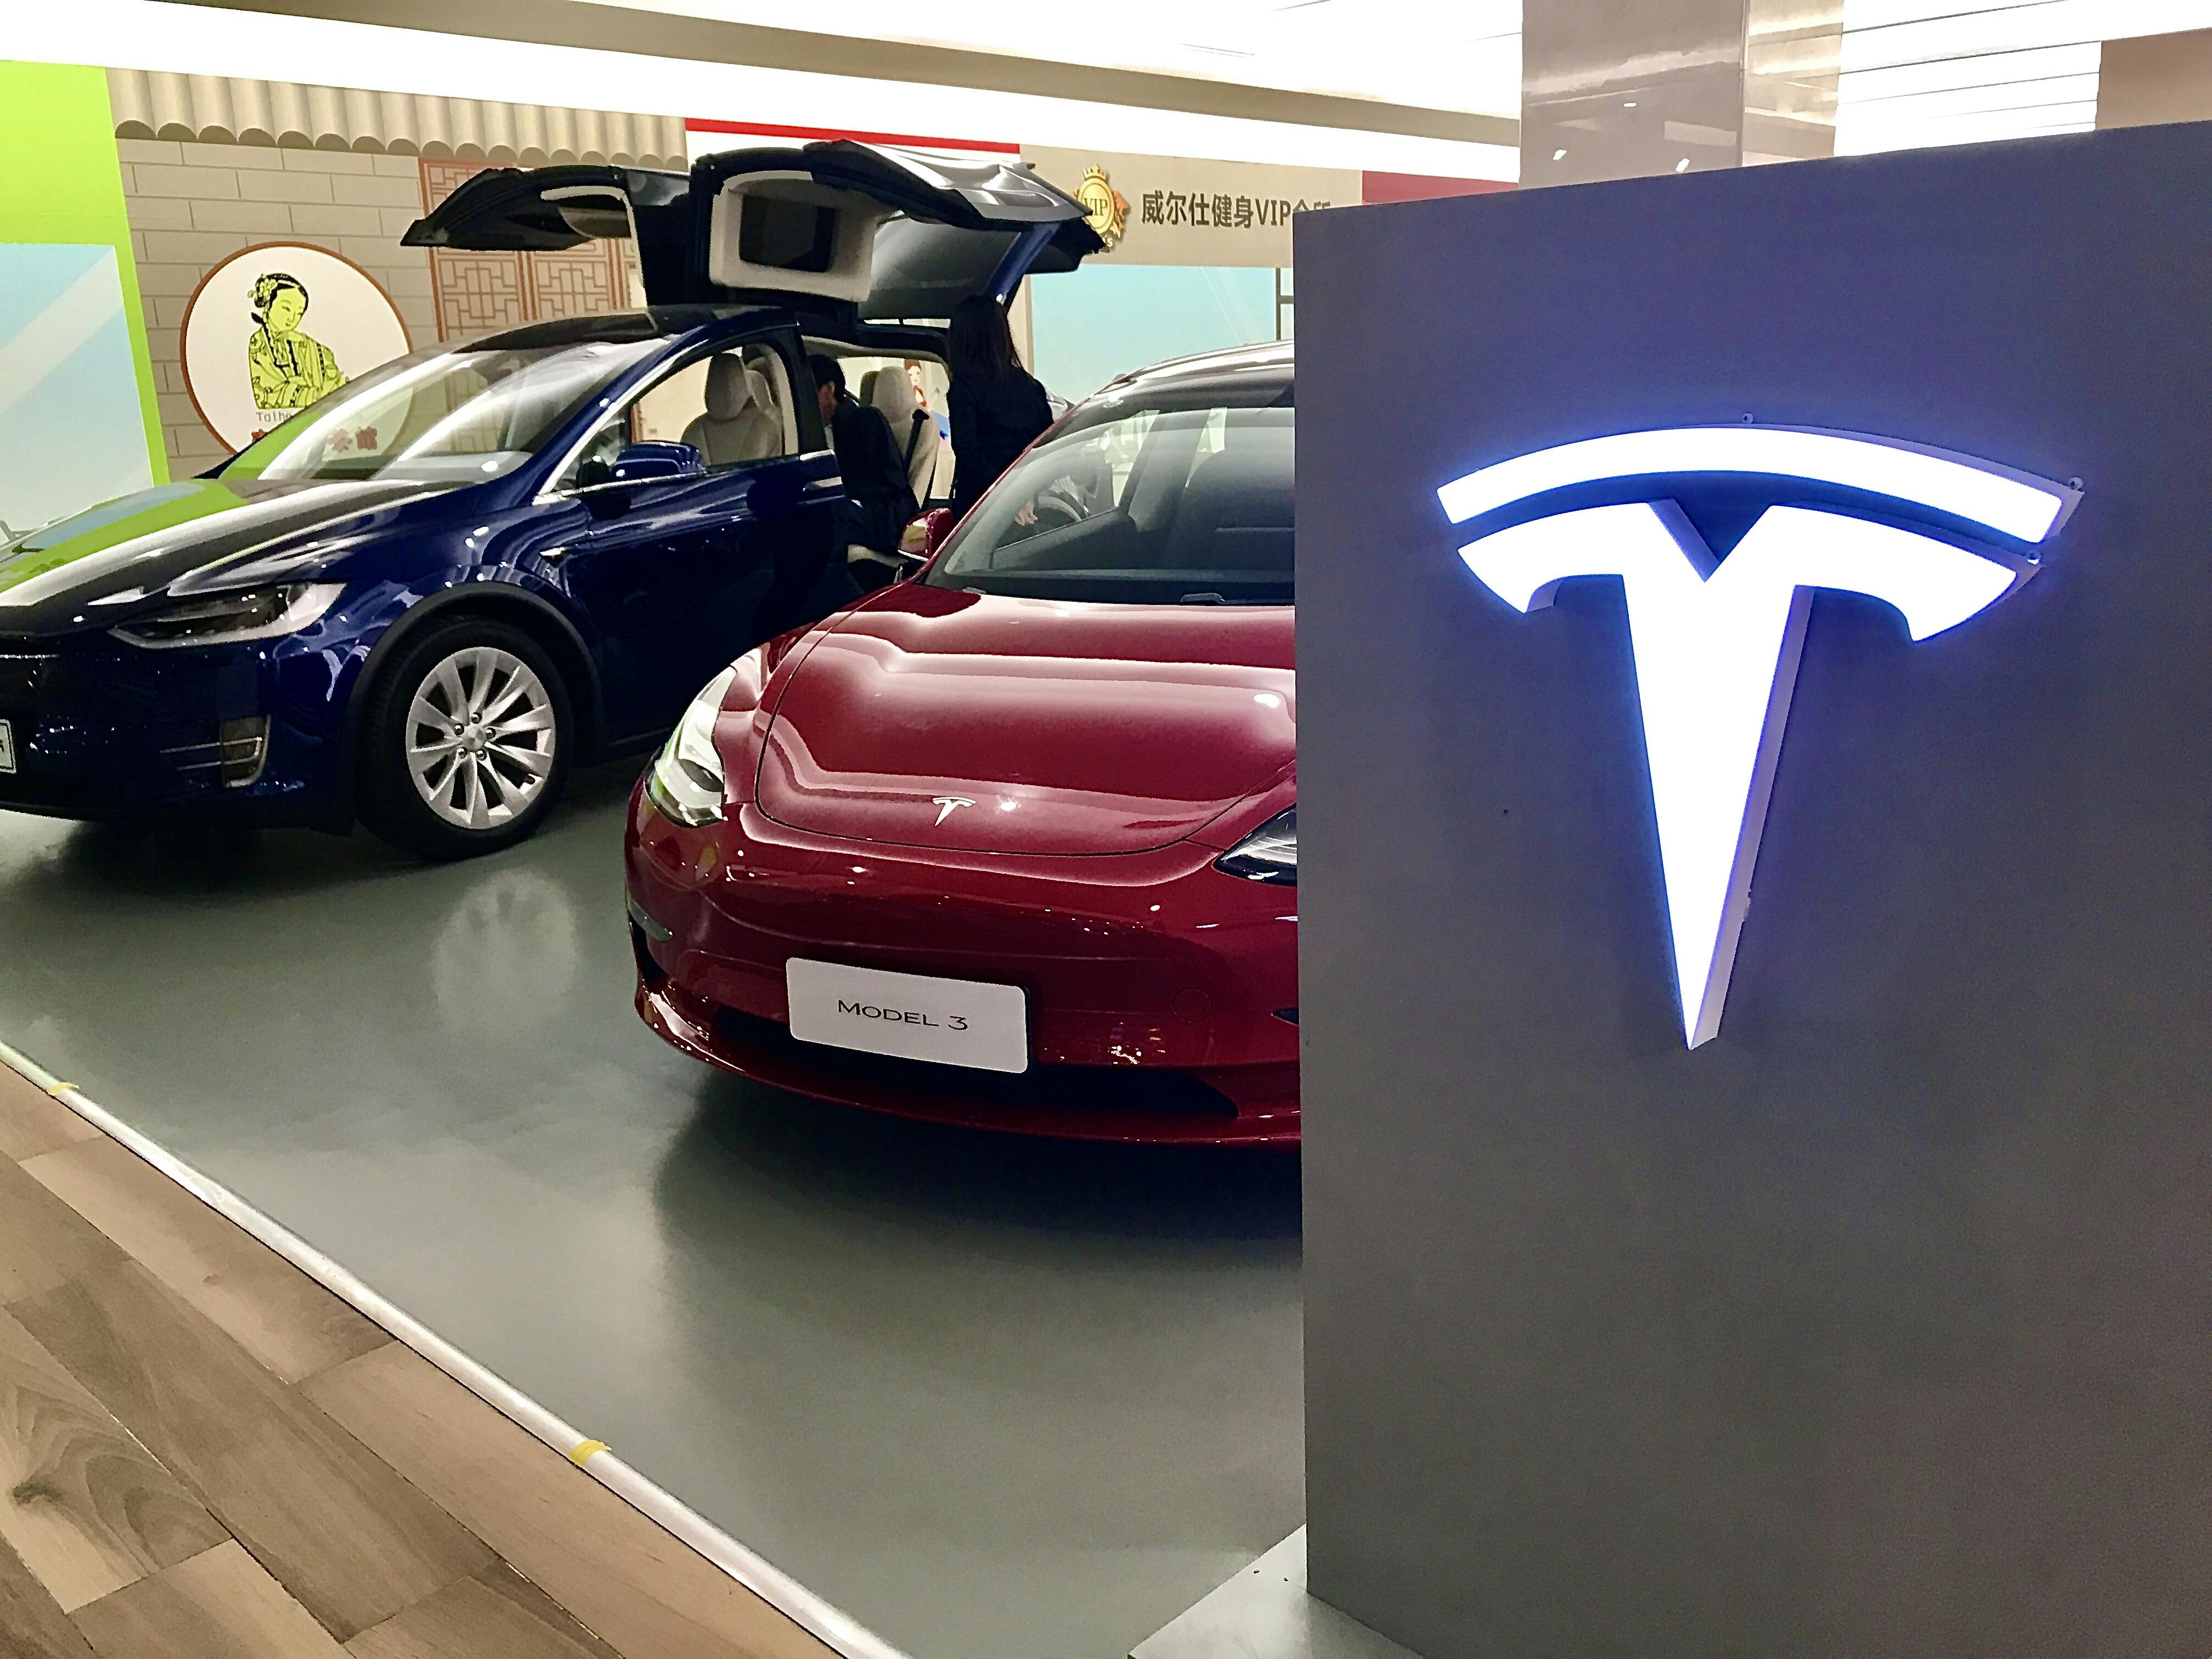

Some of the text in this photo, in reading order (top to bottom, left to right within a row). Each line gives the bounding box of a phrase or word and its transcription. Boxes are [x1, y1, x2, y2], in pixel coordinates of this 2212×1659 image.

[1084, 198, 1108, 216] VIP
[1142, 190, 1331, 229] 威尔仕健身VIP
[838, 999, 968, 1031] MODEL 3
